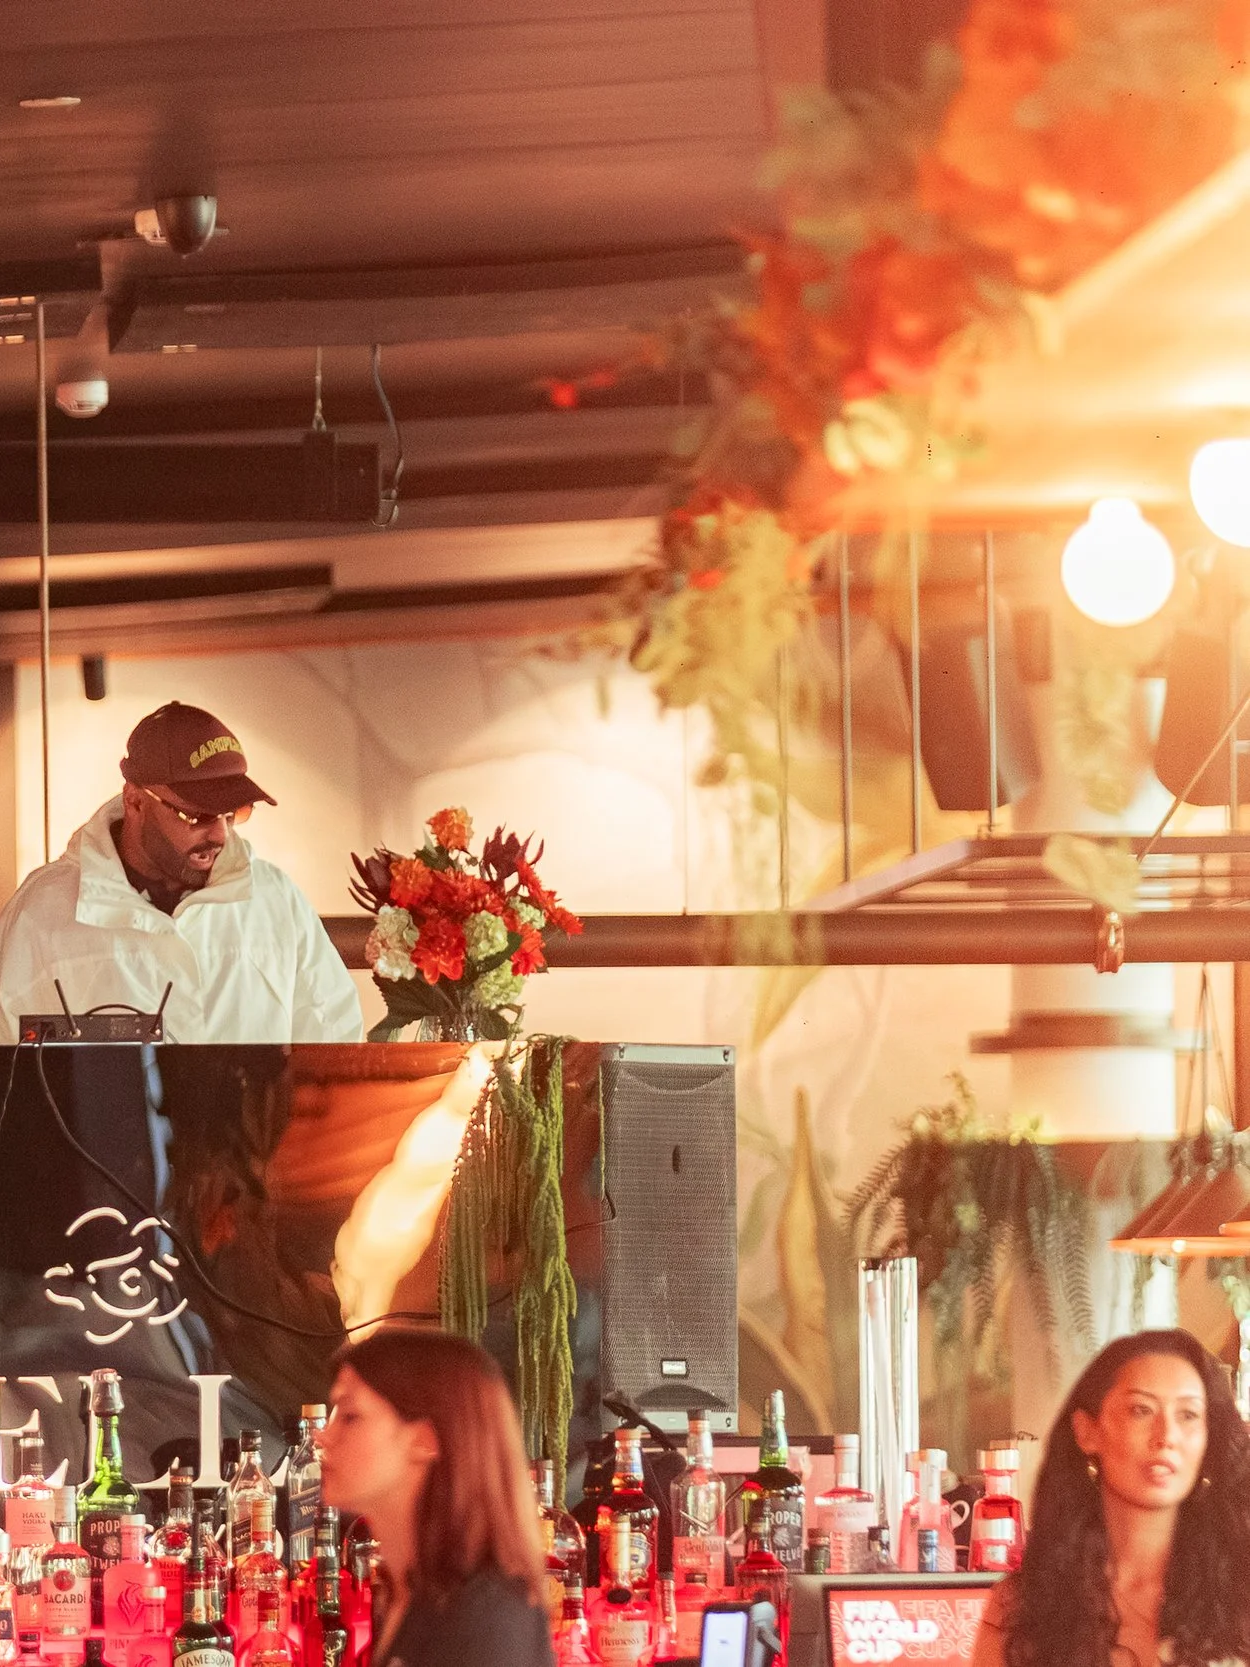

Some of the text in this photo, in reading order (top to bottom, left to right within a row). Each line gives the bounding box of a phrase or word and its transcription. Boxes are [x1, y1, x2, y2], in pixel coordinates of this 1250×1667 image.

[22, 1511, 47, 1519] HAKU
[768, 1510, 802, 1527] ROPER
[90, 1519, 121, 1537] PROP
[842, 1600, 899, 1621] FIFA
[845, 1619, 939, 1642] WORLD
[848, 1639, 902, 1663] CUP
